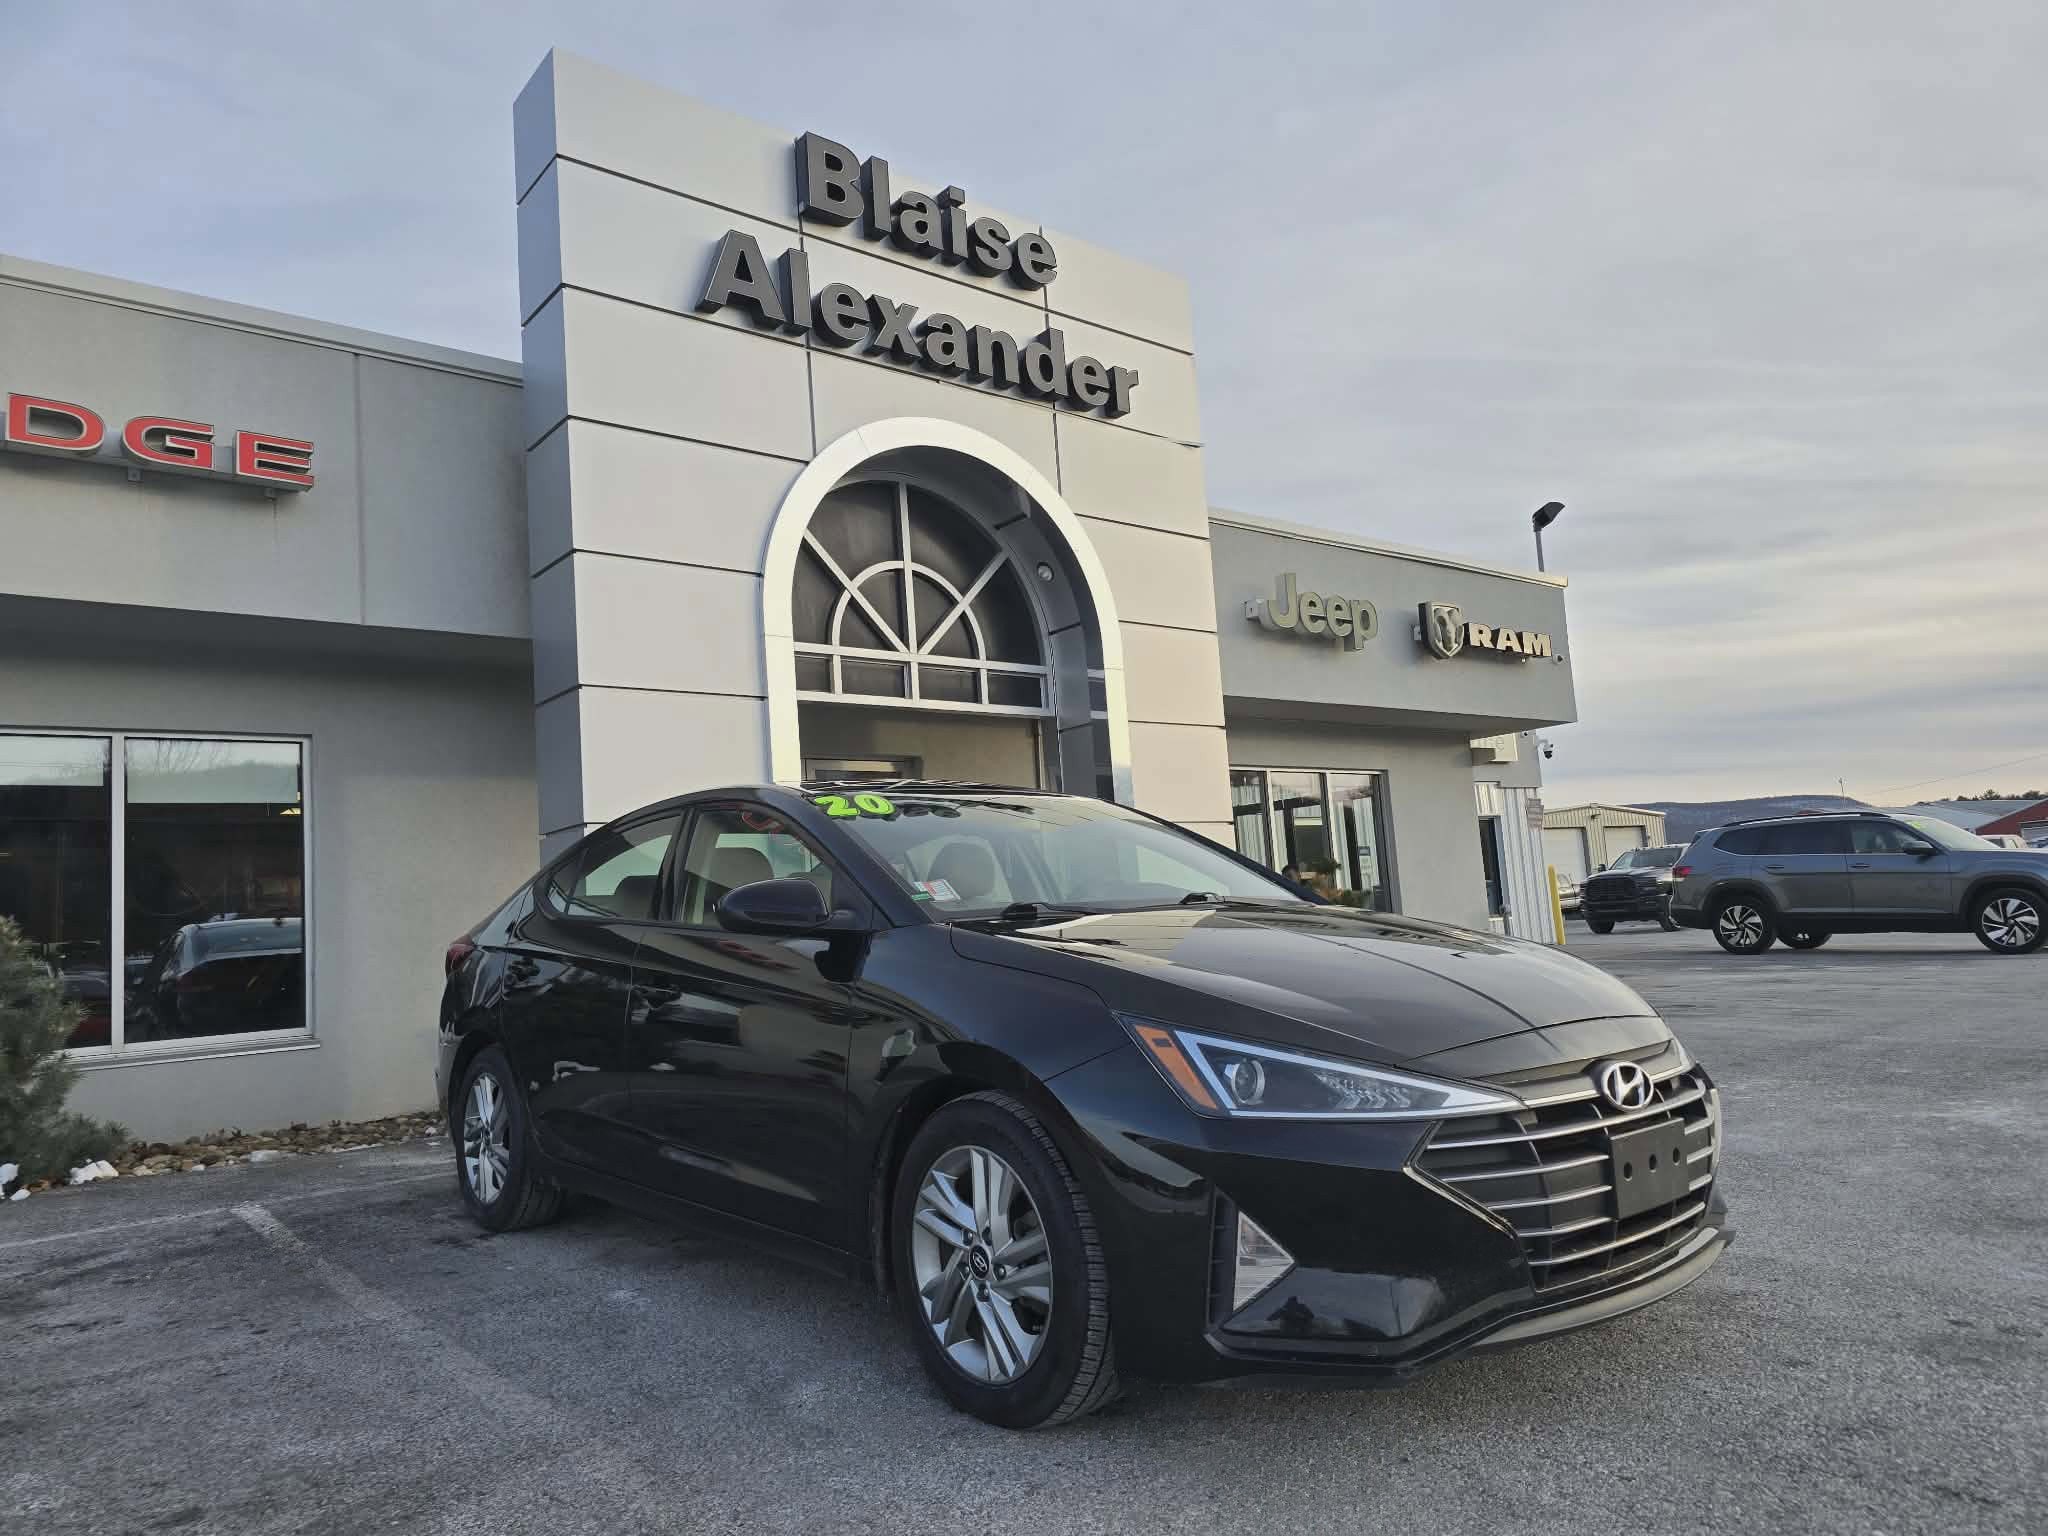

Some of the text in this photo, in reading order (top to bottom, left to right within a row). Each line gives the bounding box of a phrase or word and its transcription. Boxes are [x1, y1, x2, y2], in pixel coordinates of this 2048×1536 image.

[797, 131, 1058, 289] Blaise
[699, 229, 1138, 417] Alexander
[1267, 571, 1379, 651] Jeep
[1468, 622, 1552, 657] RAM
[815, 794, 896, 816] 20
